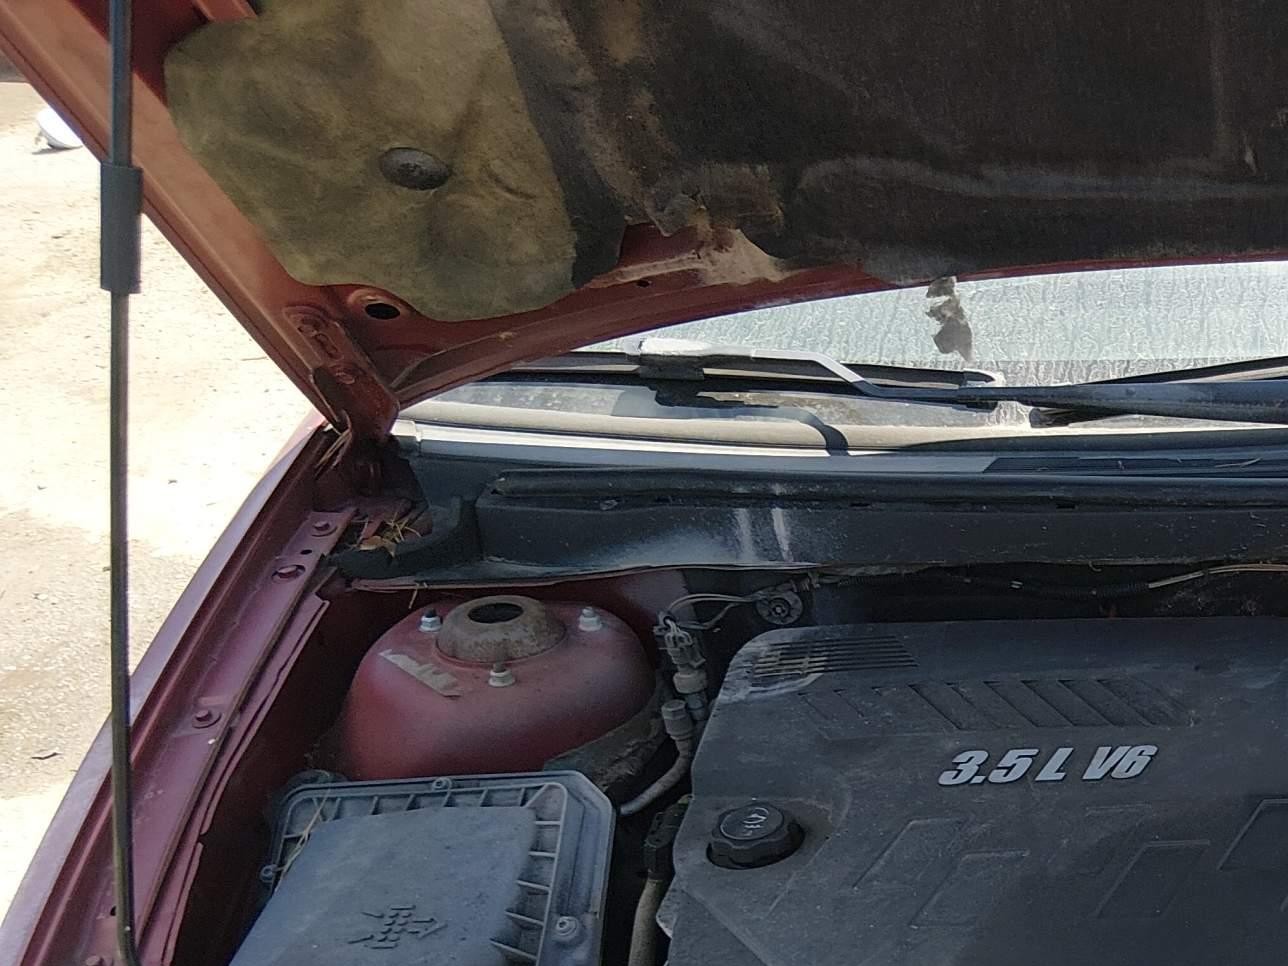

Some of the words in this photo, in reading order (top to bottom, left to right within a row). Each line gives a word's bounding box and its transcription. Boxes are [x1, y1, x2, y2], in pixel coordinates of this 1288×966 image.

[938, 748, 1040, 786] 3.5
[1035, 747, 1074, 782] L
[1082, 745, 1158, 781] V6
